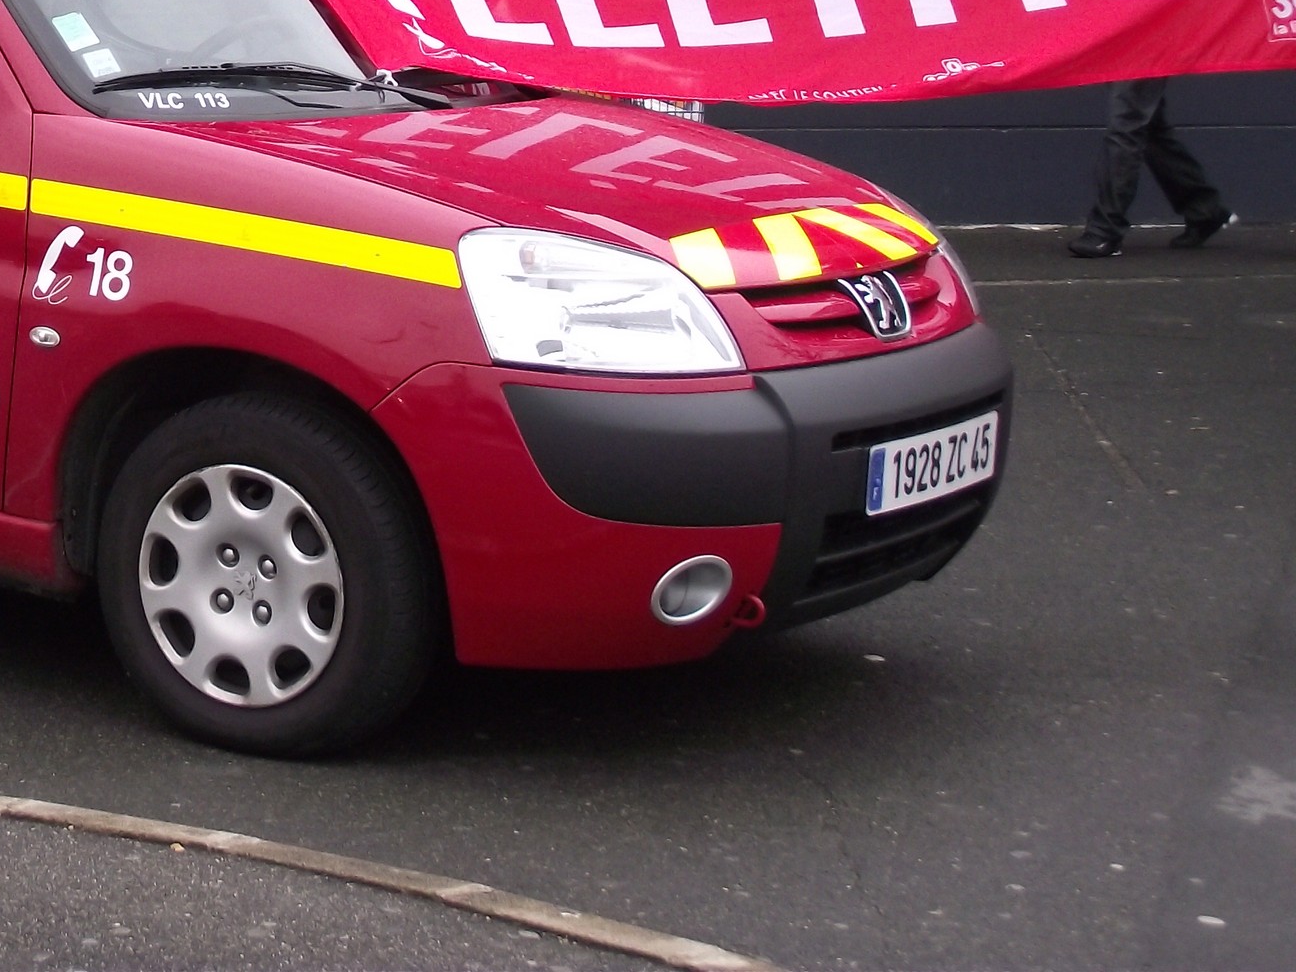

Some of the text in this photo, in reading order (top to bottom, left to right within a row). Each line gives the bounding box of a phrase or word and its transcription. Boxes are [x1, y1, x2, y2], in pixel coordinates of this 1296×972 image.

[137, 92, 230, 109] VLC 113
[86, 247, 133, 301] 18
[893, 422, 992, 499] 1928 ZC 45
